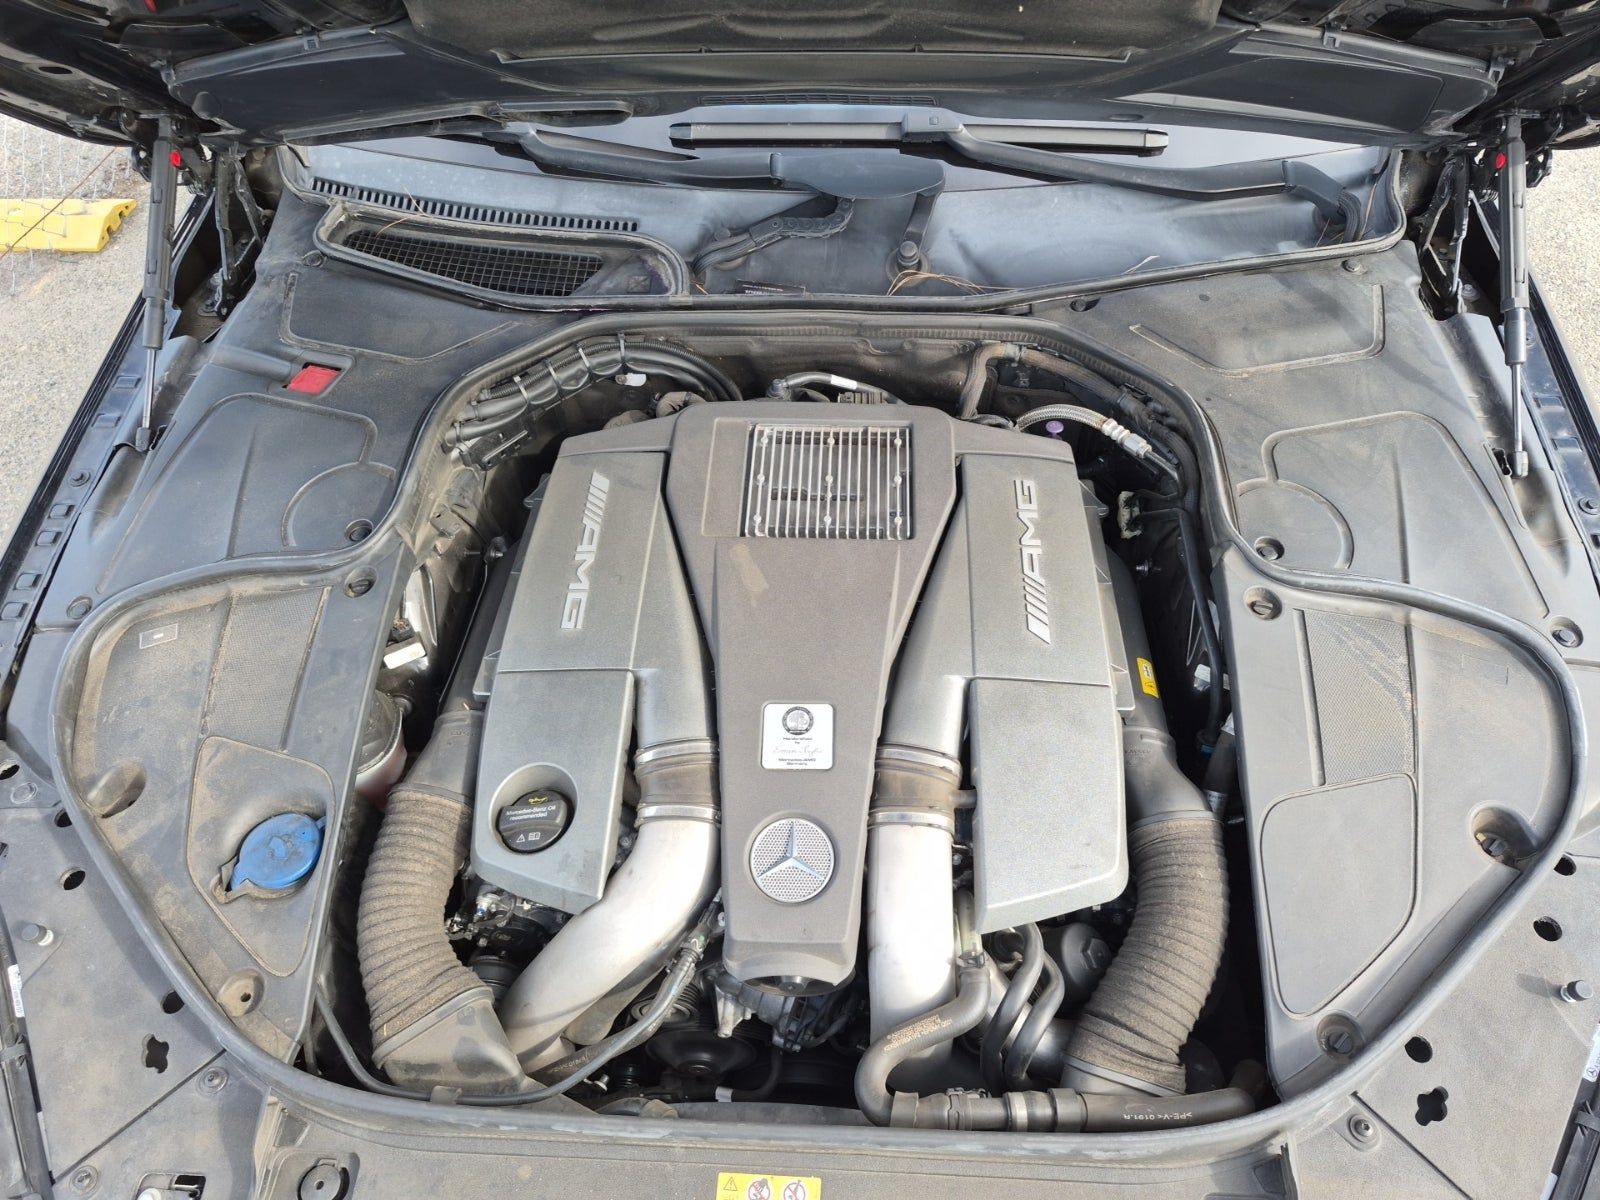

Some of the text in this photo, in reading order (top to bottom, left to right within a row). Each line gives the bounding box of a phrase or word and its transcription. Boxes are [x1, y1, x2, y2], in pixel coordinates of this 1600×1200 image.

[1014, 479, 1046, 588] AMG
[561, 512, 602, 629] AMG
[505, 806, 547, 816] Mercedes-Benz
[509, 811, 548, 821] recommended
